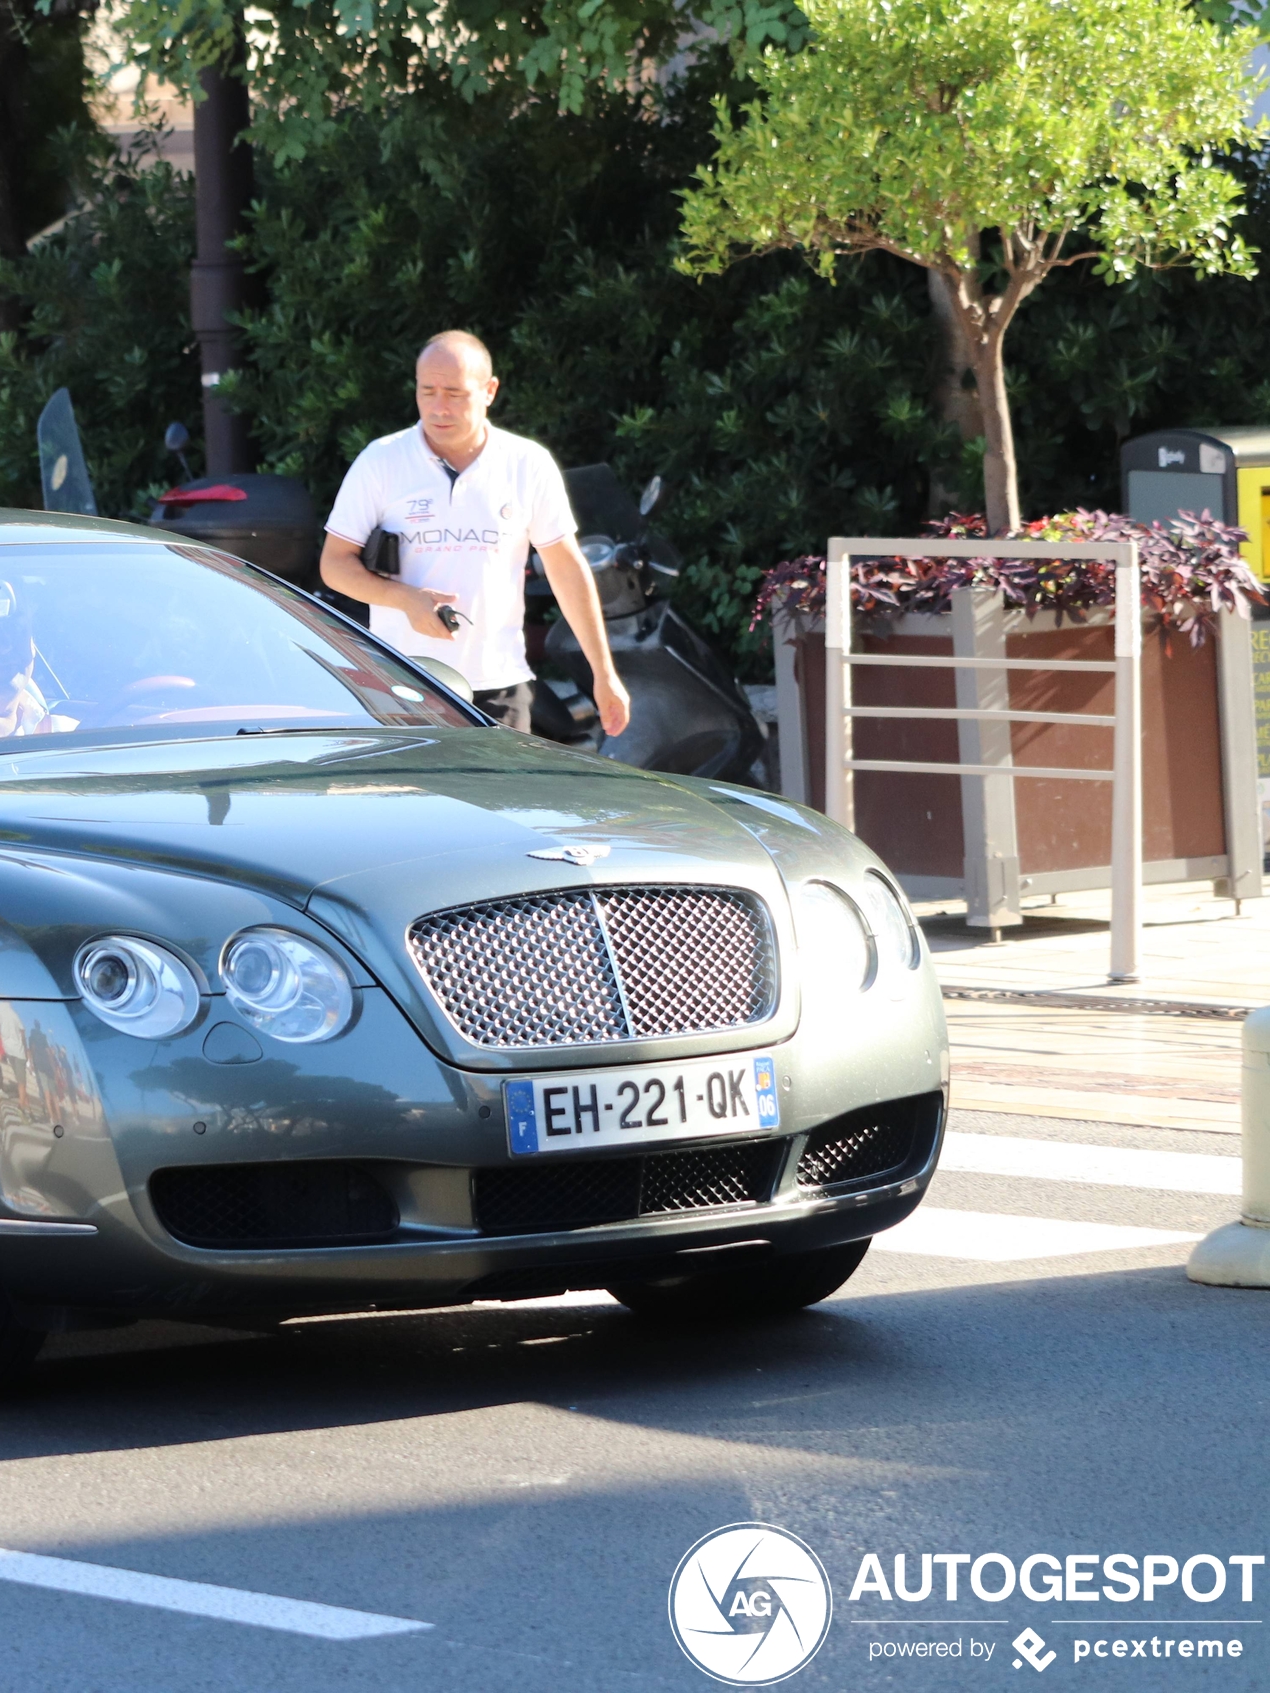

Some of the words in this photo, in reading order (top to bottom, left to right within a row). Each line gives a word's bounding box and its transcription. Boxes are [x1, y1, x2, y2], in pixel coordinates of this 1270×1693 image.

[399, 528, 513, 545] MONAC
[542, 1068, 751, 1137] EH-221-QK
[758, 1093, 776, 1117] 06
[518, 1121, 528, 1137] F
